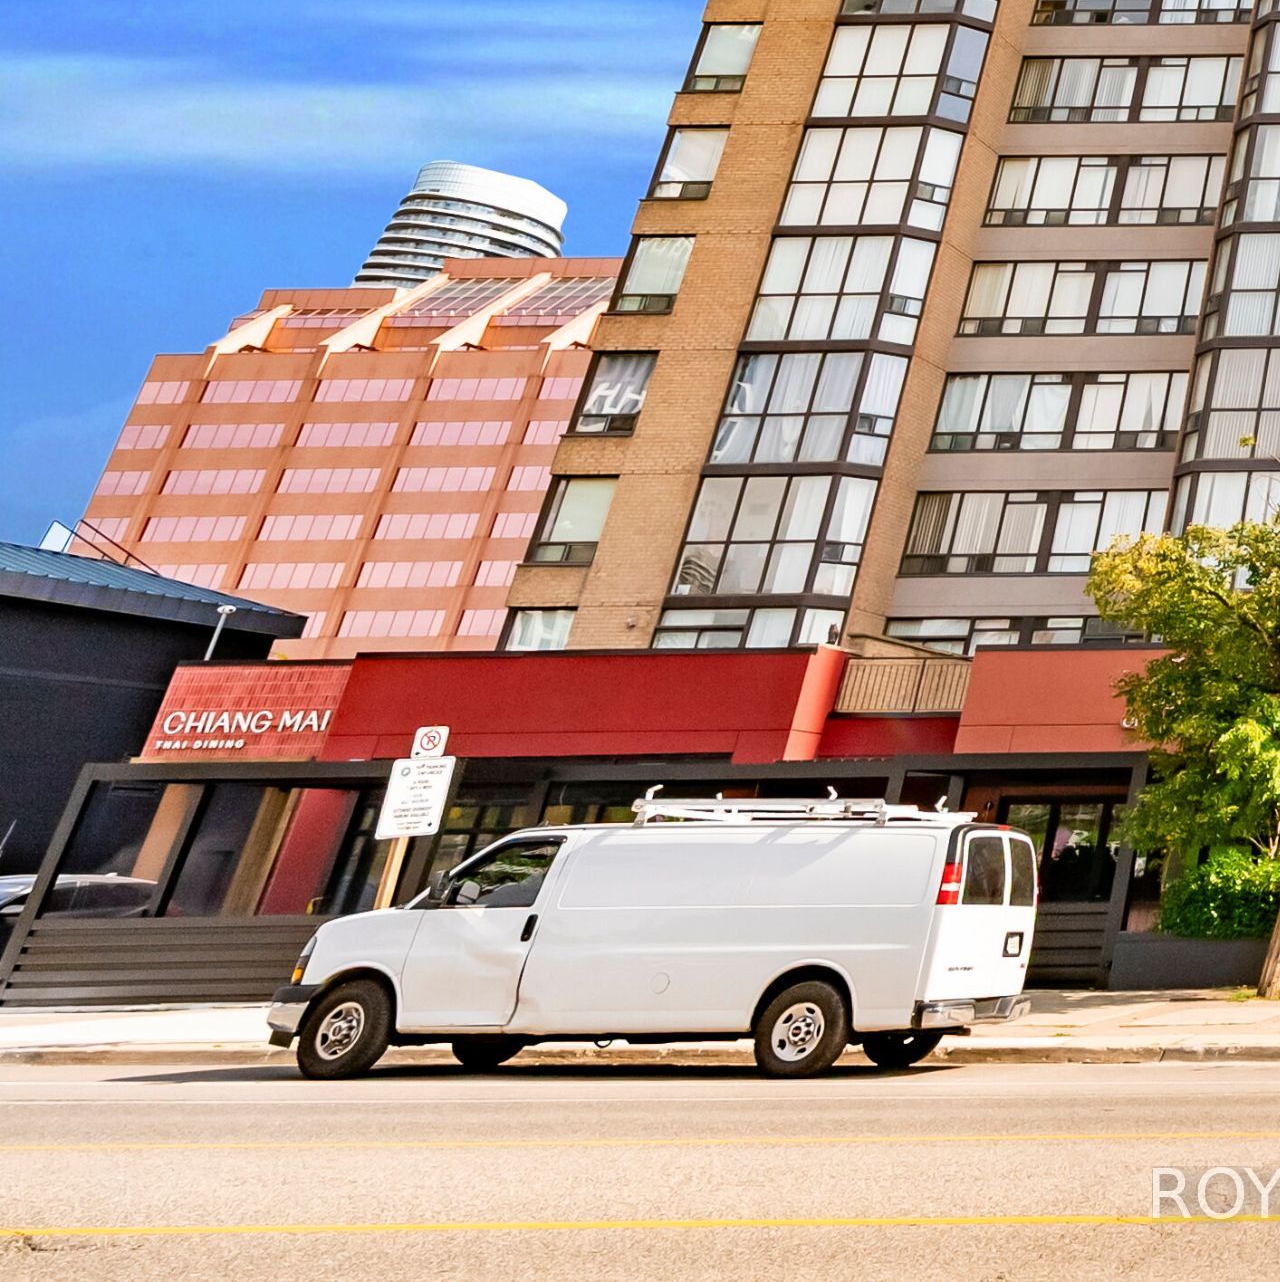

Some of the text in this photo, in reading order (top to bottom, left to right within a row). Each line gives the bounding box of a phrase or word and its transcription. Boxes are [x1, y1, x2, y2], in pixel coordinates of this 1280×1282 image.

[163, 709, 333, 735] CHIANG MAI
[154, 738, 246, 750] THAI DINING
